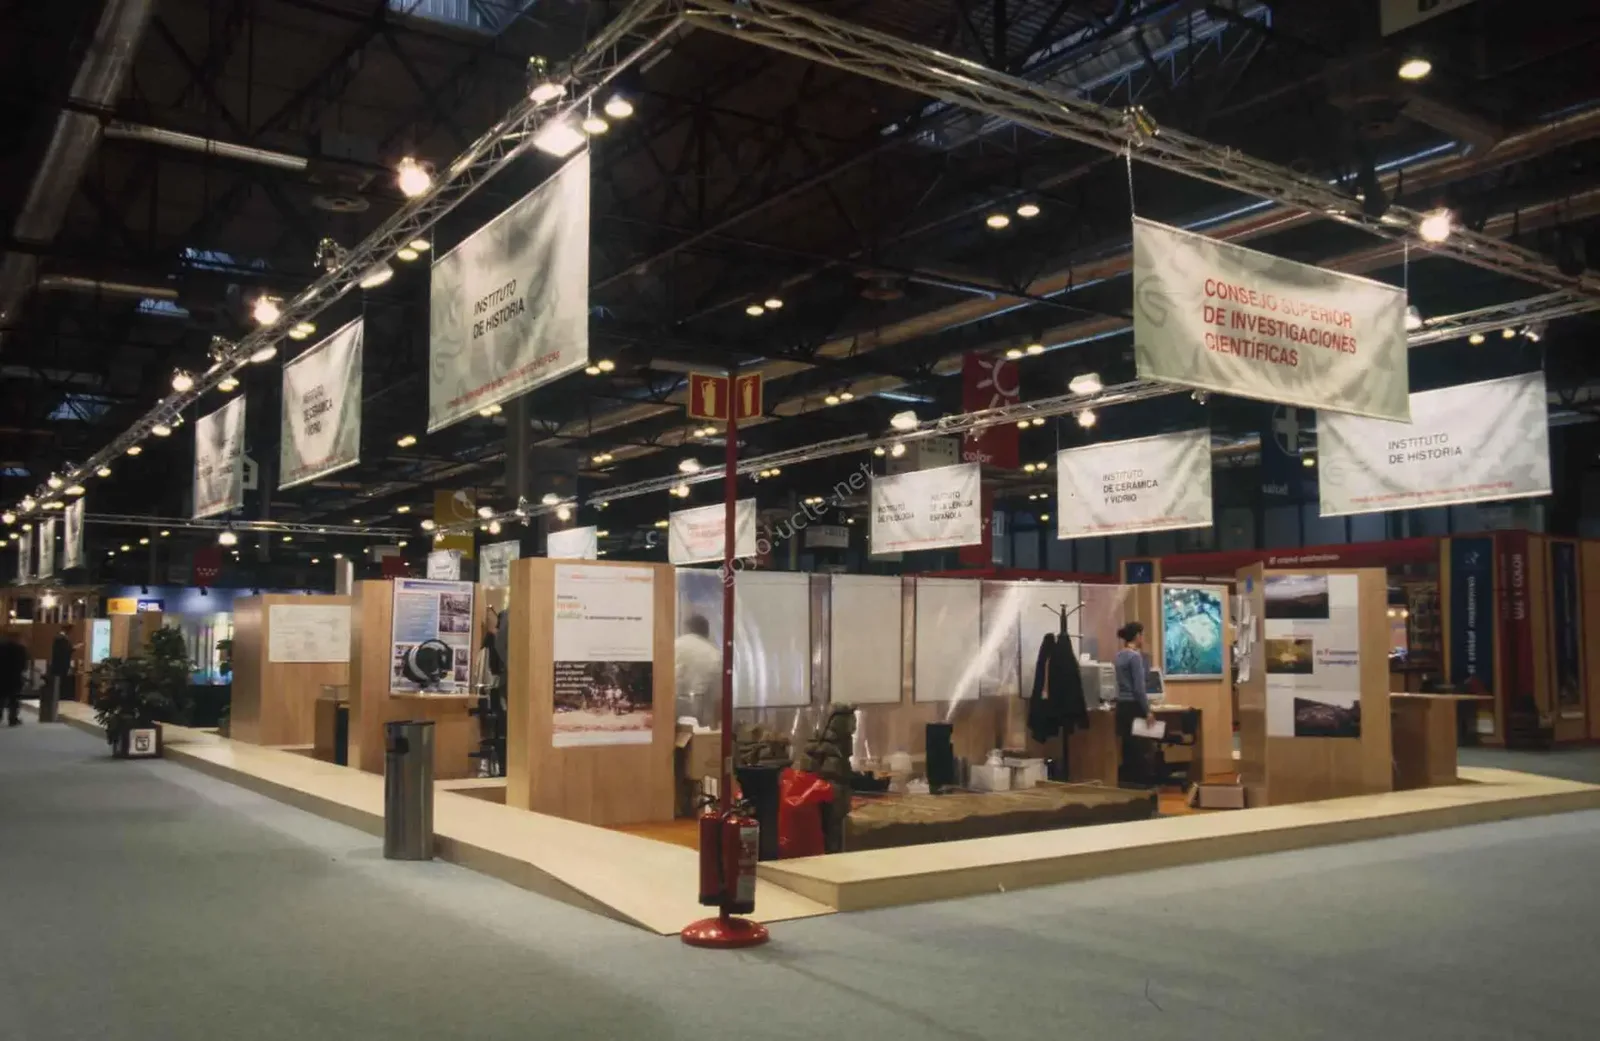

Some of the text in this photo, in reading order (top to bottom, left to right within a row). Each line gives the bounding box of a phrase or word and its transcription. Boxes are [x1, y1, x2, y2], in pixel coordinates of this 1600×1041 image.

[473, 279, 517, 317] INSTITUTO
[1204, 278, 1353, 329] CONSEJO SUPERIOR
[473, 297, 525, 339] DE HISTORIA
[1203, 305, 1357, 355] DE INVESTIGACIONES
[1204, 332, 1298, 367] CIENTÍFICAS
[1388, 433, 1449, 450] INSTITUTO
[963, 450, 993, 463] color
[1388, 446, 1463, 465] DE HISTORIA
[1102, 469, 1144, 482] INSTITUTO
[1103, 483, 1114, 494] DE
[1110, 493, 1137, 504] VIDRIO
